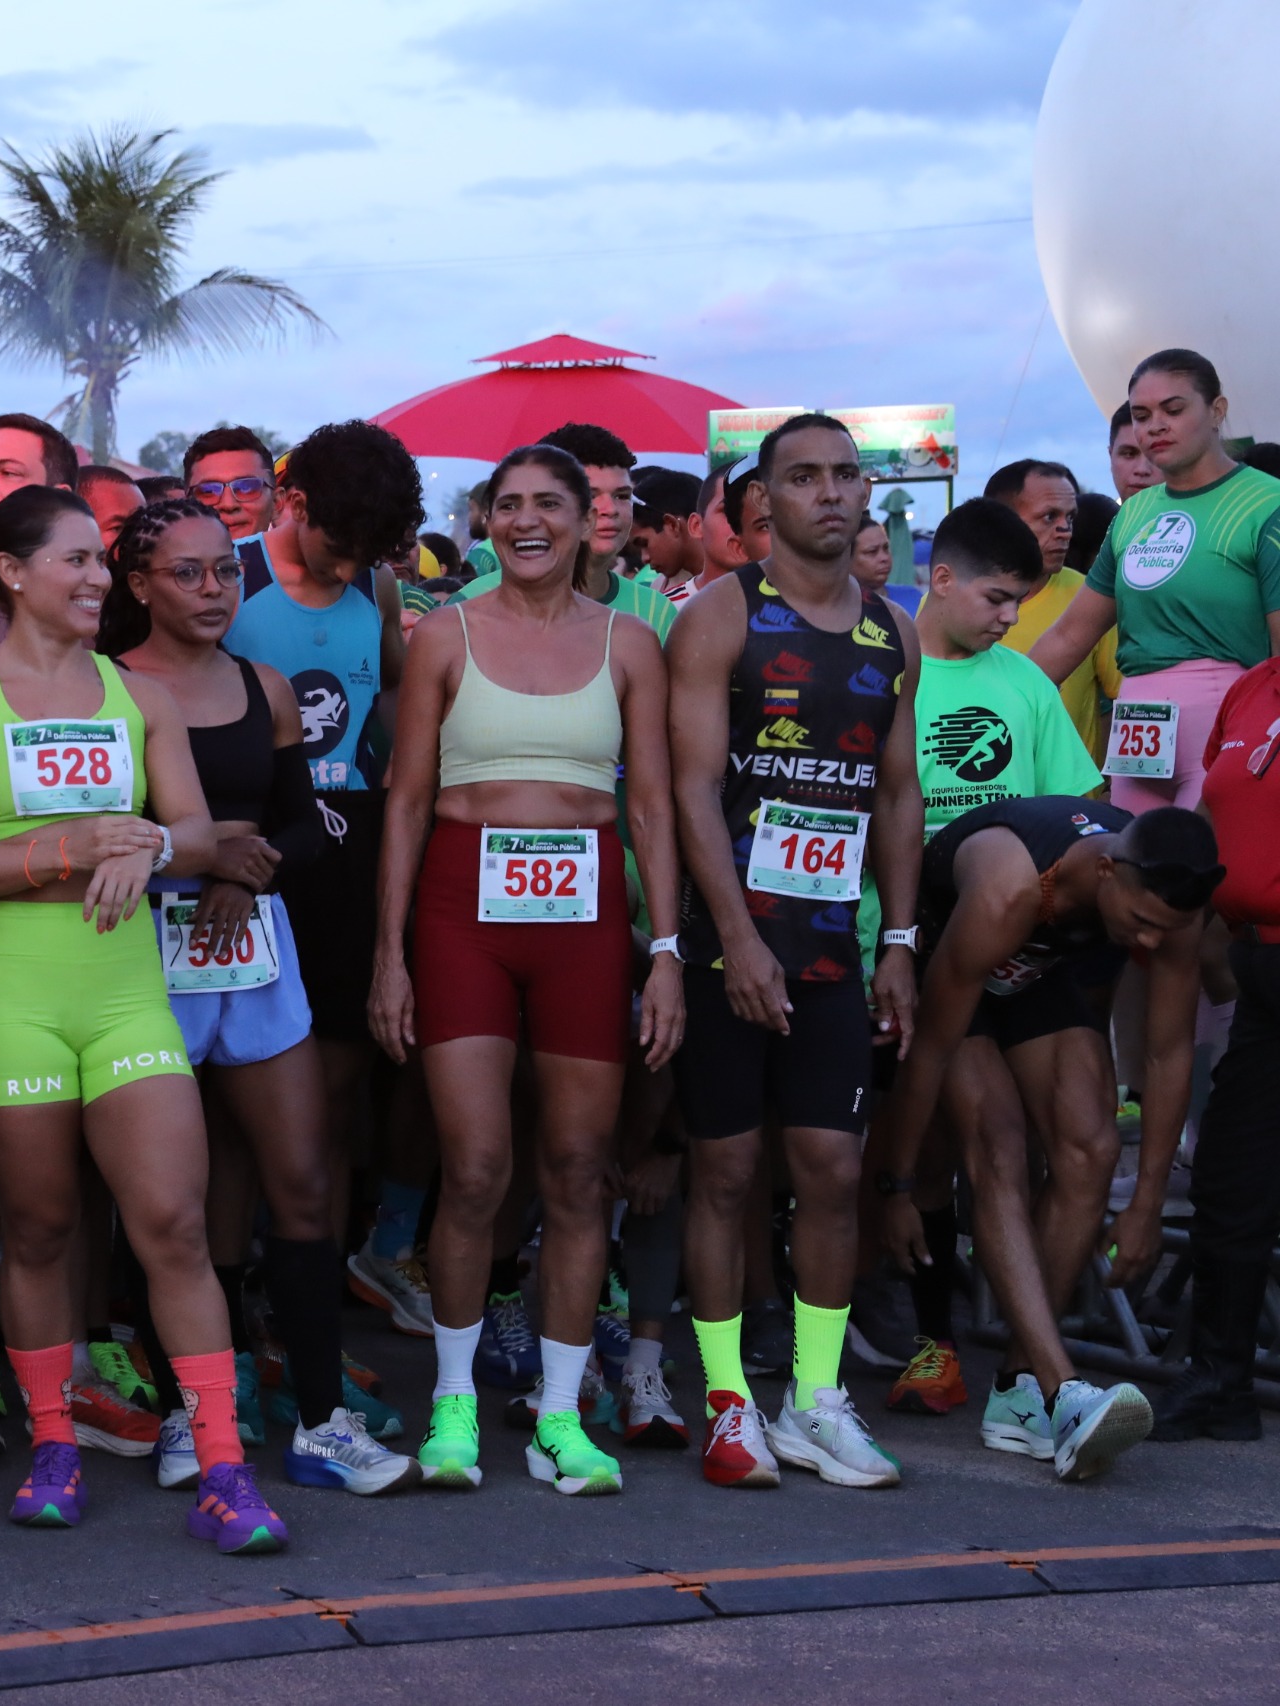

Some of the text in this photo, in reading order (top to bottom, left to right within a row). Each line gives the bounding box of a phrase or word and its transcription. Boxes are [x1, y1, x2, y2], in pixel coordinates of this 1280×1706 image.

[1128, 542, 1184, 555] Defensoria
[1136, 556, 1174, 568] Pública
[861, 616, 889, 643] NIKE
[54, 731, 87, 740] Defensoria
[87, 731, 110, 740] Pública
[769, 717, 810, 744] NIKE
[1118, 724, 1161, 757] 253
[37, 747, 112, 787] 528
[931, 787, 955, 795] EQUIPE
[525, 842, 558, 852] Defensoria
[559, 841, 581, 851] Pública
[780, 833, 846, 876] 164
[504, 858, 578, 897] 582
[113, 1050, 185, 1075] MORE
[7, 1074, 62, 1096] RUN
